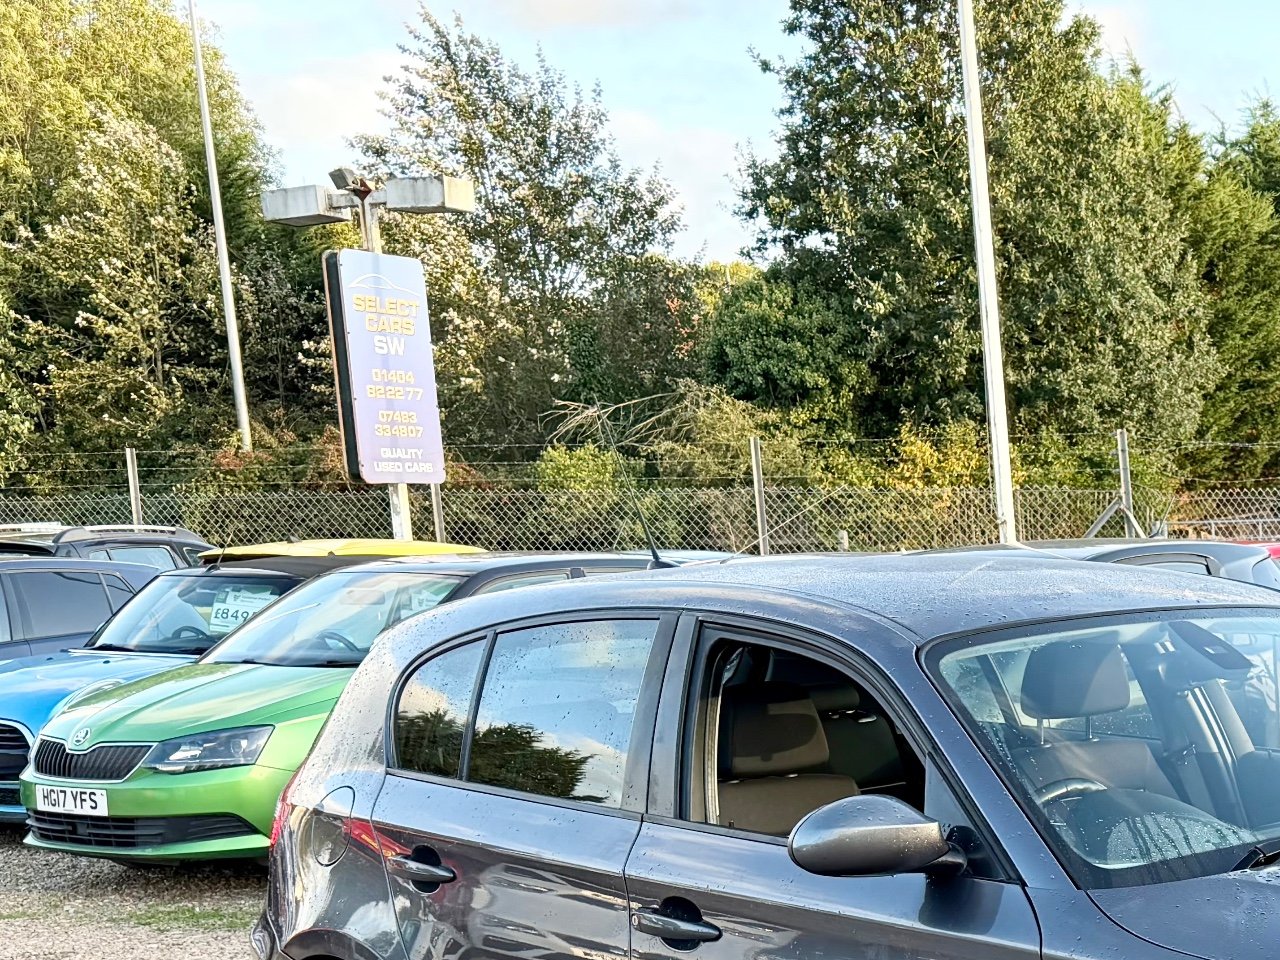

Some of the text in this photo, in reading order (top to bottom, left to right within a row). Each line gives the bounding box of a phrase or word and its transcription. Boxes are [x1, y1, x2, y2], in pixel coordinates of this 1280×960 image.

[353, 294, 420, 317] SELECT
[366, 313, 415, 336] CARS
[374, 335, 405, 356] SW
[372, 369, 414, 384] 01404
[379, 410, 418, 424] 07483
[375, 424, 423, 438] 334807
[381, 448, 423, 460] QUALITY
[374, 461, 433, 472] USED CARS
[213, 608, 258, 623] £849
[42, 788, 98, 810] HG17 YFS
